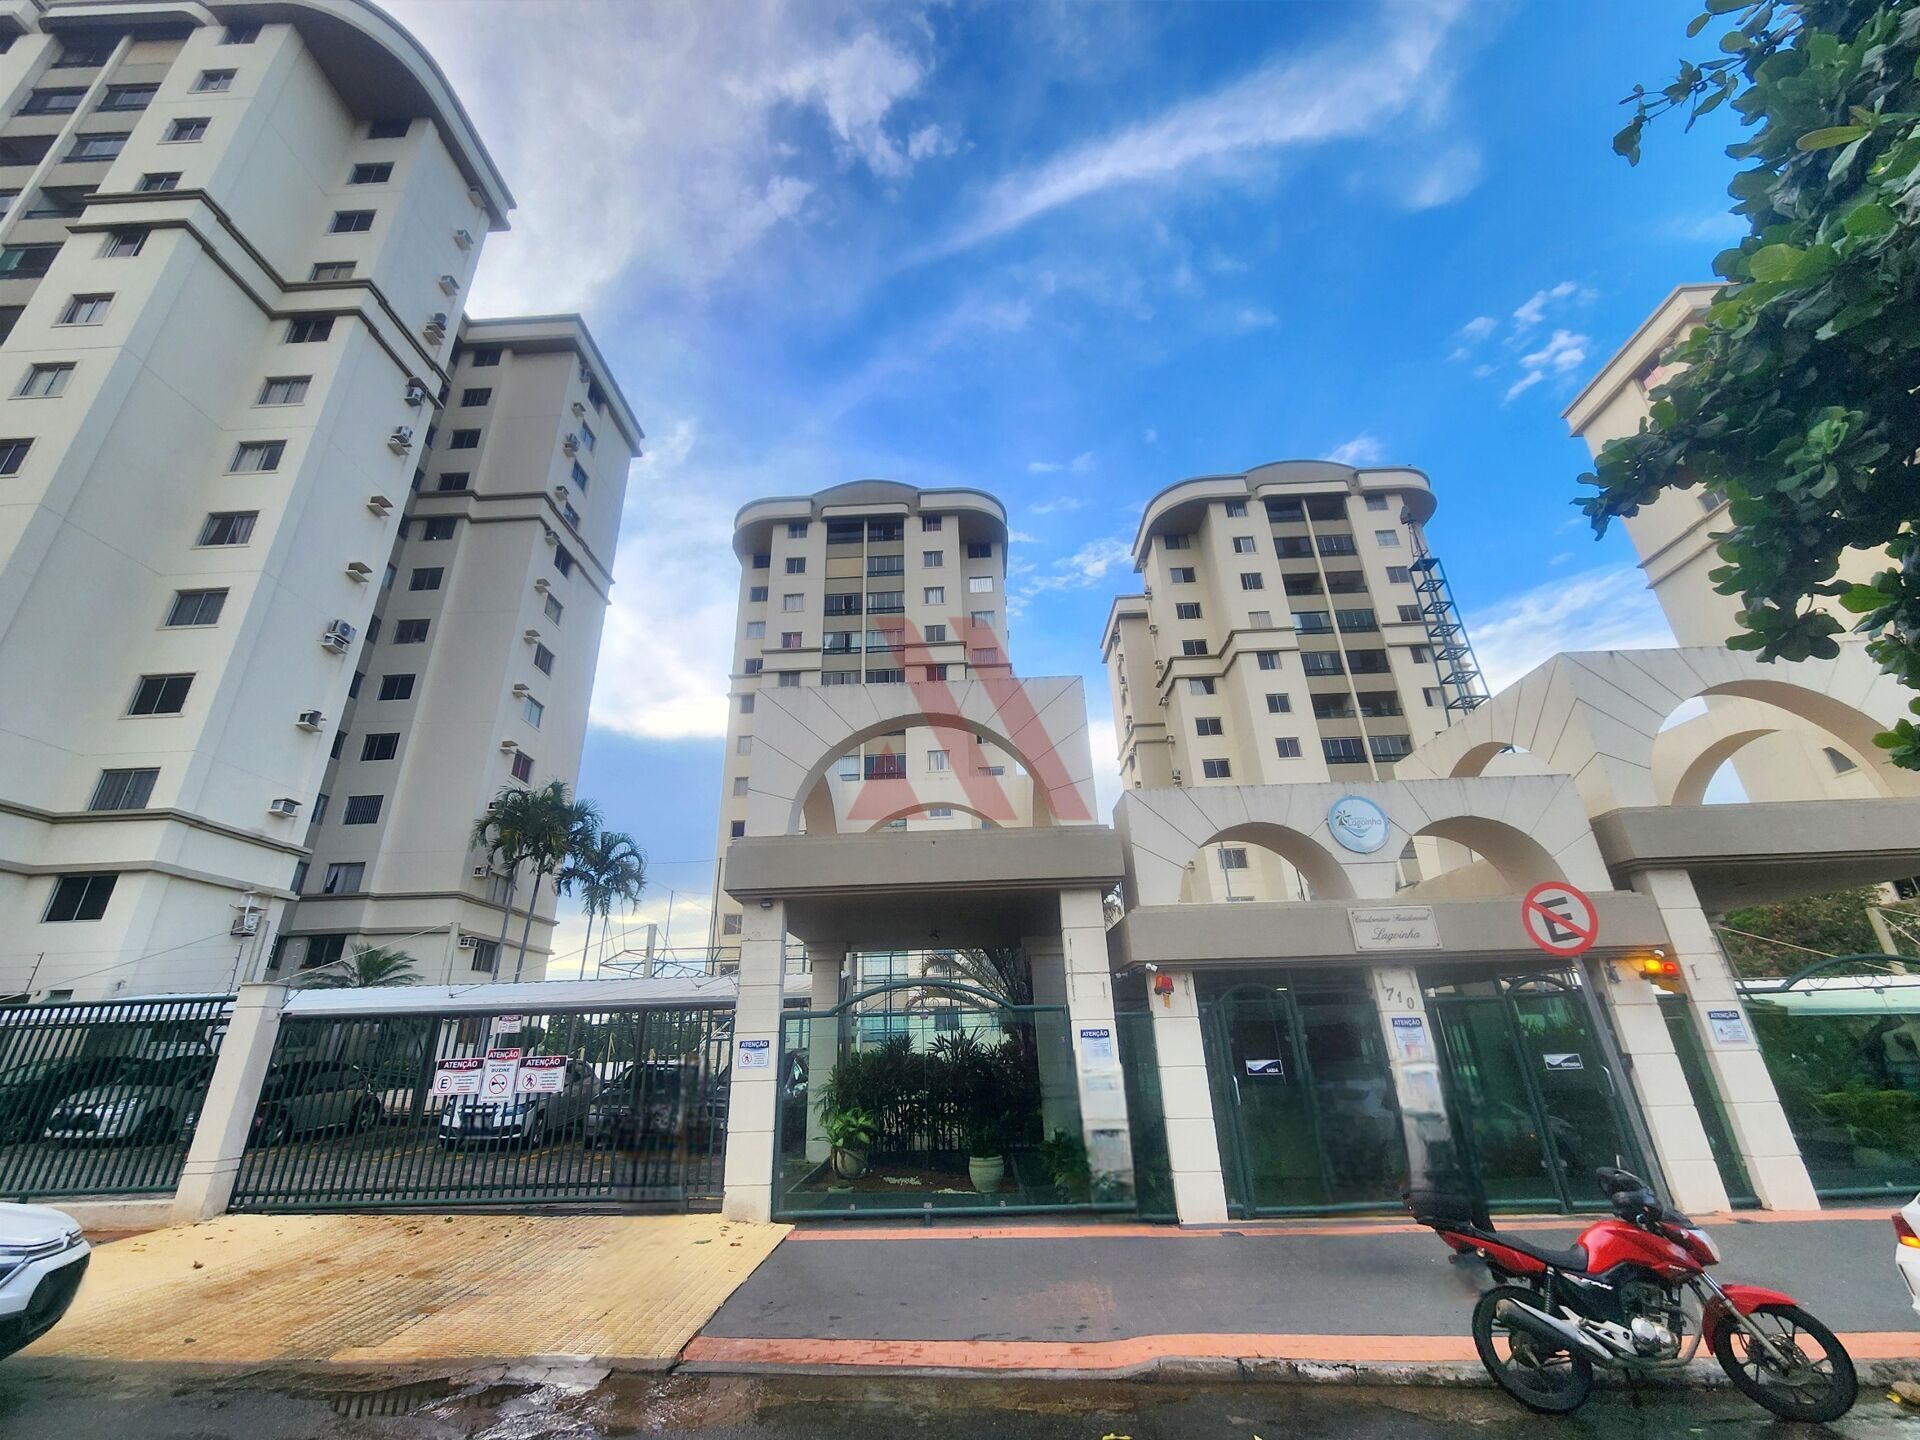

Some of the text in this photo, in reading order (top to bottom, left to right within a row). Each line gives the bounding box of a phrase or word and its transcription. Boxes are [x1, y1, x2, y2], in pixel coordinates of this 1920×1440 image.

[1539, 896, 1580, 943] E
[1371, 928, 1420, 943] Lagoinha
[1386, 987, 1415, 1010] 710
[489, 1050, 518, 1059] ATENÇÃO
[444, 1060, 478, 1069] ATENÇÃO
[526, 1058, 560, 1067] ATENÇÃO
[440, 1079, 448, 1089] E
